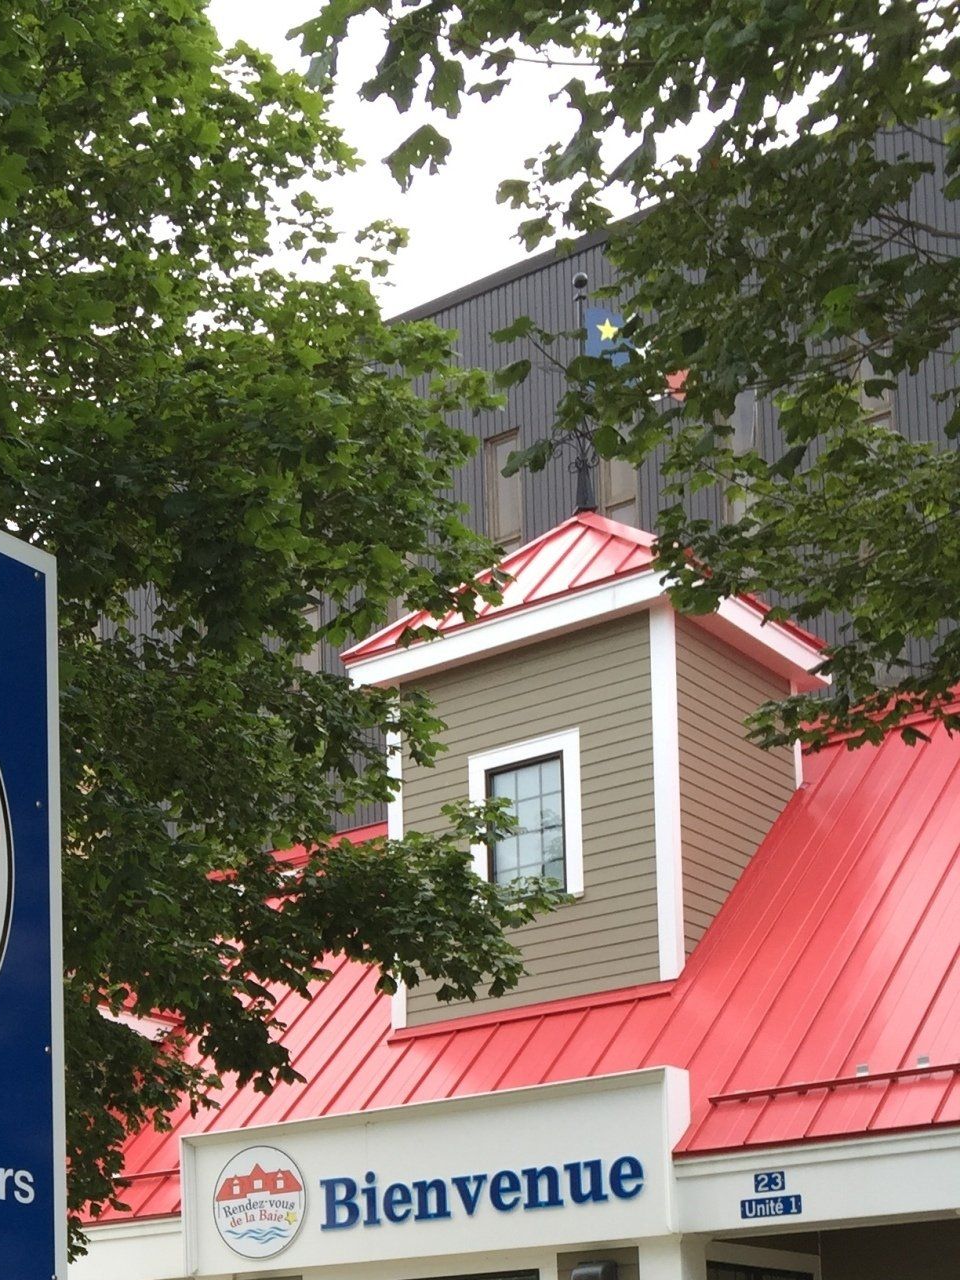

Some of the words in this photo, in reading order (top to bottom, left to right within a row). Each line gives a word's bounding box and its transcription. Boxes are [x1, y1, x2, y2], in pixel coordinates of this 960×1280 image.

[757, 1173, 783, 1192] 23
[320, 1155, 645, 1231] Bienvenue
[223, 1198, 296, 1219] Rendez-vous
[745, 1198, 784, 1217] Unité
[790, 1197, 798, 1213] 1
[229, 1216, 243, 1229] de
[245, 1212, 256, 1224] la
[259, 1209, 284, 1224] Baie
